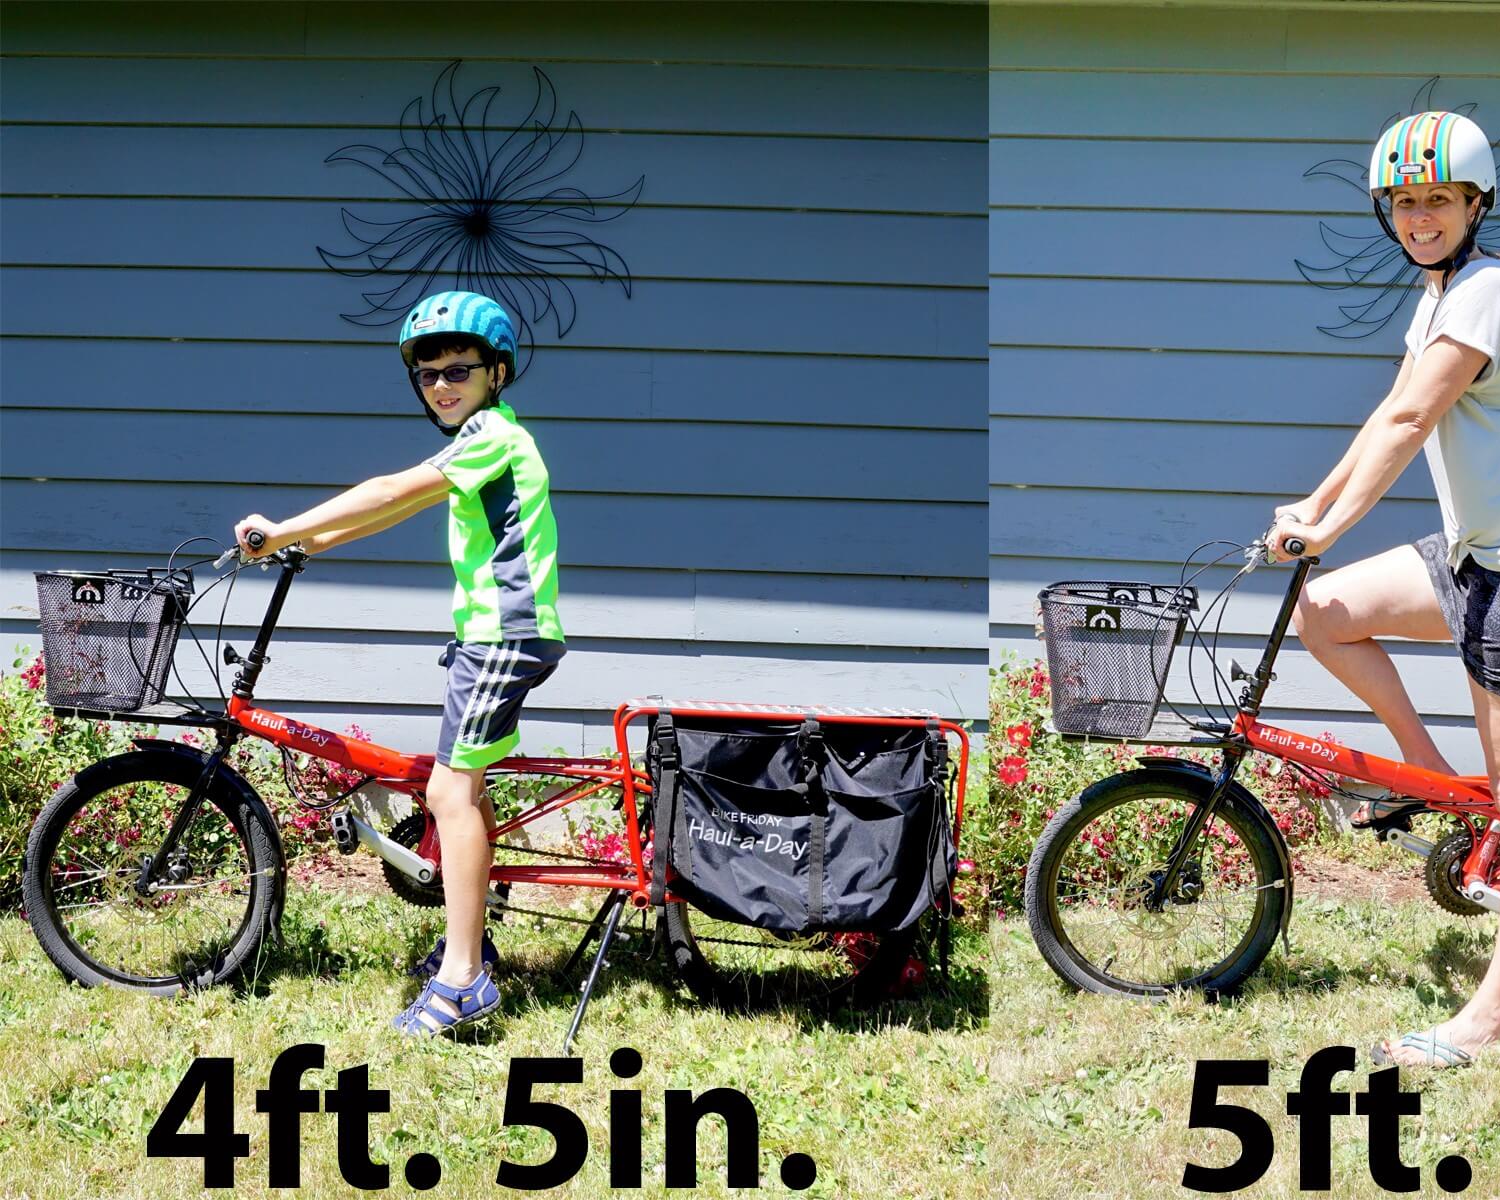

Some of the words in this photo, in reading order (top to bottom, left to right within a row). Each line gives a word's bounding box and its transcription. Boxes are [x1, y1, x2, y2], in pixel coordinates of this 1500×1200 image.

[251, 711, 328, 747] Haul-a-Day
[1260, 728, 1338, 762] Haul-a-Day
[711, 807, 739, 823] BIKE
[740, 812, 783, 827] FRIDAY
[689, 819, 808, 860] Haul-a-Day
